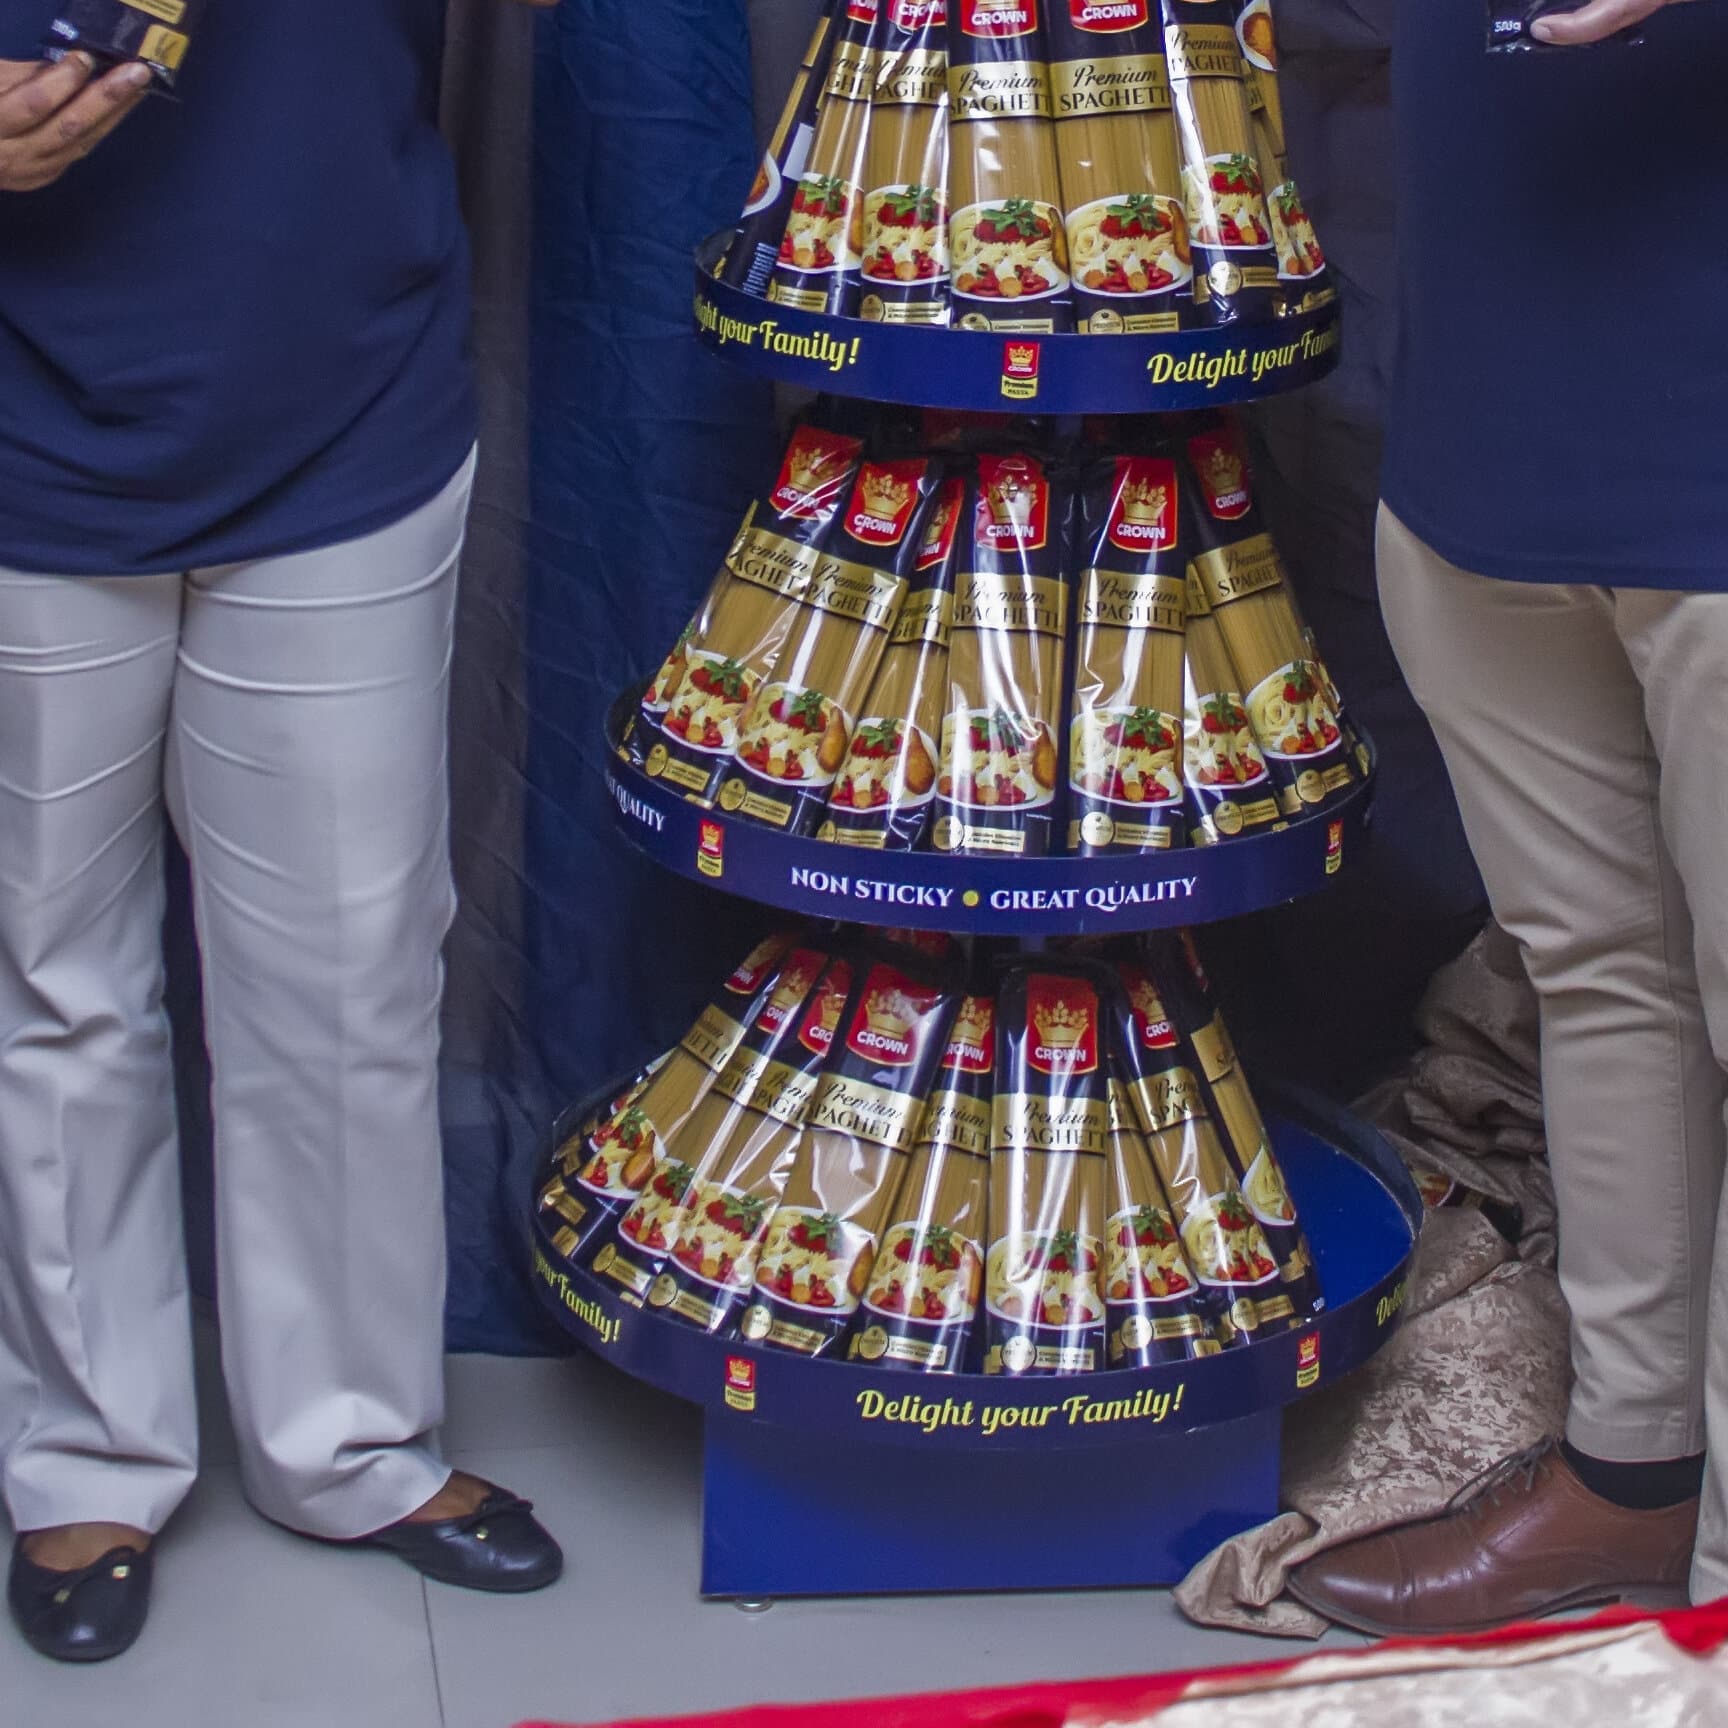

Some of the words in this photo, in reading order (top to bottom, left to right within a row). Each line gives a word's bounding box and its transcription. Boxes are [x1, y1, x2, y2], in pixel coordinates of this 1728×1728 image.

[971, 10, 1027, 26] CROWN
[1082, 4, 1138, 20] CROWN
[959, 69, 1043, 92] Premium
[1072, 64, 1158, 88] Premium
[719, 316, 758, 345] your
[1146, 348, 1246, 389] Delight
[1251, 342, 1300, 382] your
[1215, 491, 1247, 509] CROWN
[853, 513, 897, 535] CROWN
[1117, 522, 1166, 539] CROWN
[618, 793, 666, 832] QUALITY
[790, 866, 850, 895] NON
[854, 880, 954, 907] STICKY
[990, 888, 1080, 910] GREAT
[1084, 876, 1197, 912] QUALITY
[856, 1030, 909, 1057] CROWN
[1035, 1045, 1087, 1062] CROWN
[855, 1388, 975, 1432] Delight
[980, 1404, 1058, 1435] your
[1062, 1382, 1185, 1424] Family!
